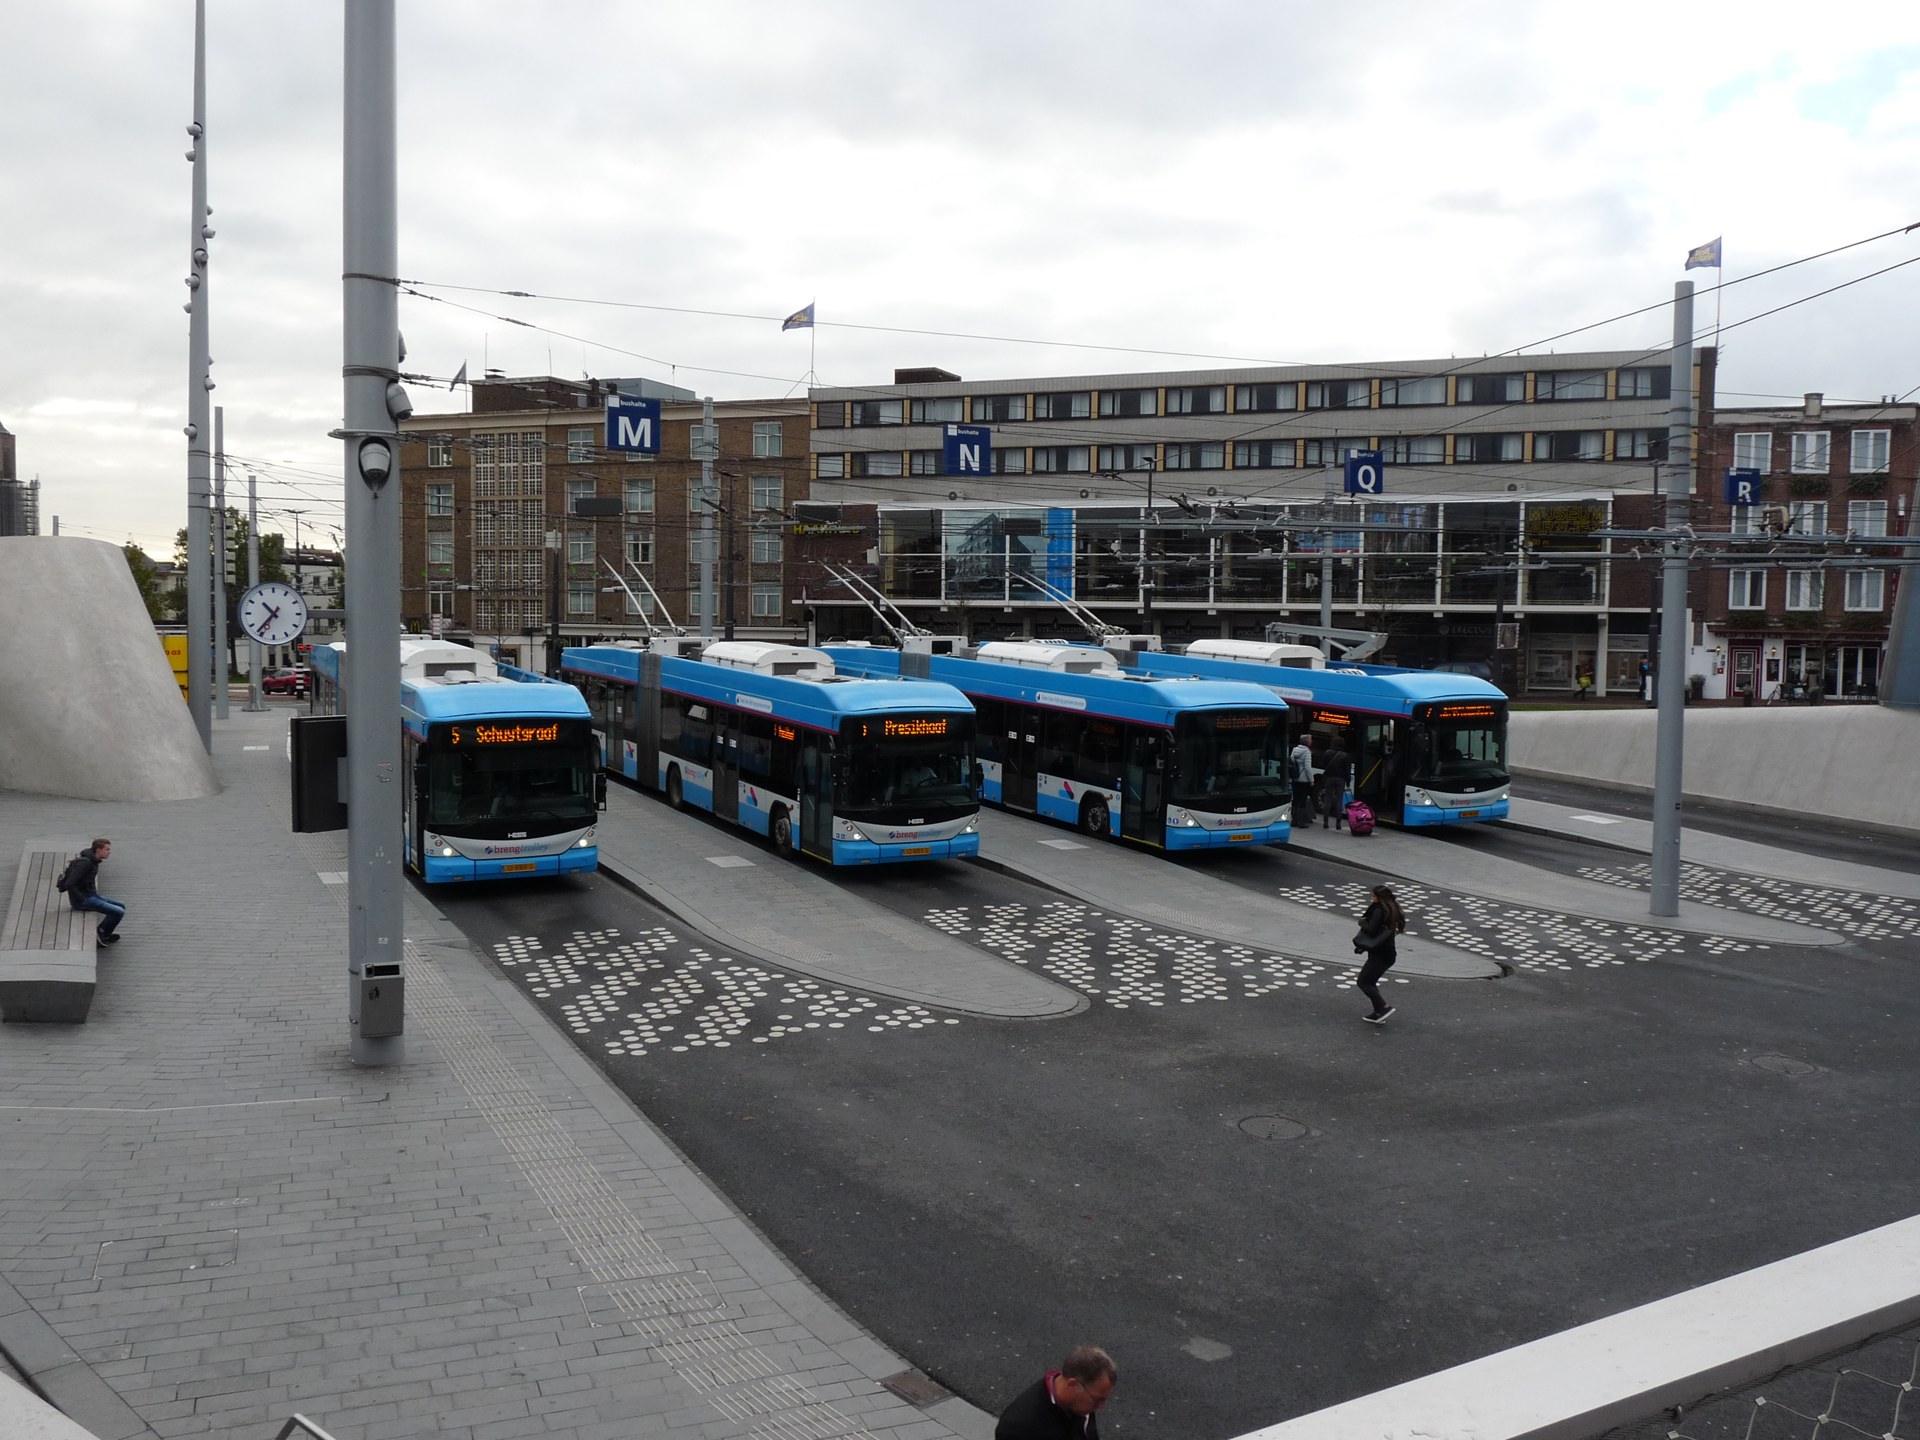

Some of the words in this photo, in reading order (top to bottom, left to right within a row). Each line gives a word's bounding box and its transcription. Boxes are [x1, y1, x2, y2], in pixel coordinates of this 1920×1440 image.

[620, 400, 647, 408] bushalte
[618, 416, 651, 448] M
[959, 443, 980, 472] N
[1357, 464, 1376, 493] Q
[1738, 481, 1752, 503] R
[1529, 505, 1604, 521] MUSEUM
[451, 726, 461, 744] 5
[475, 723, 559, 743] Schuytgraaf
[885, 718, 948, 736] Presikhaaf
[494, 843, 550, 855] brengtrolley
